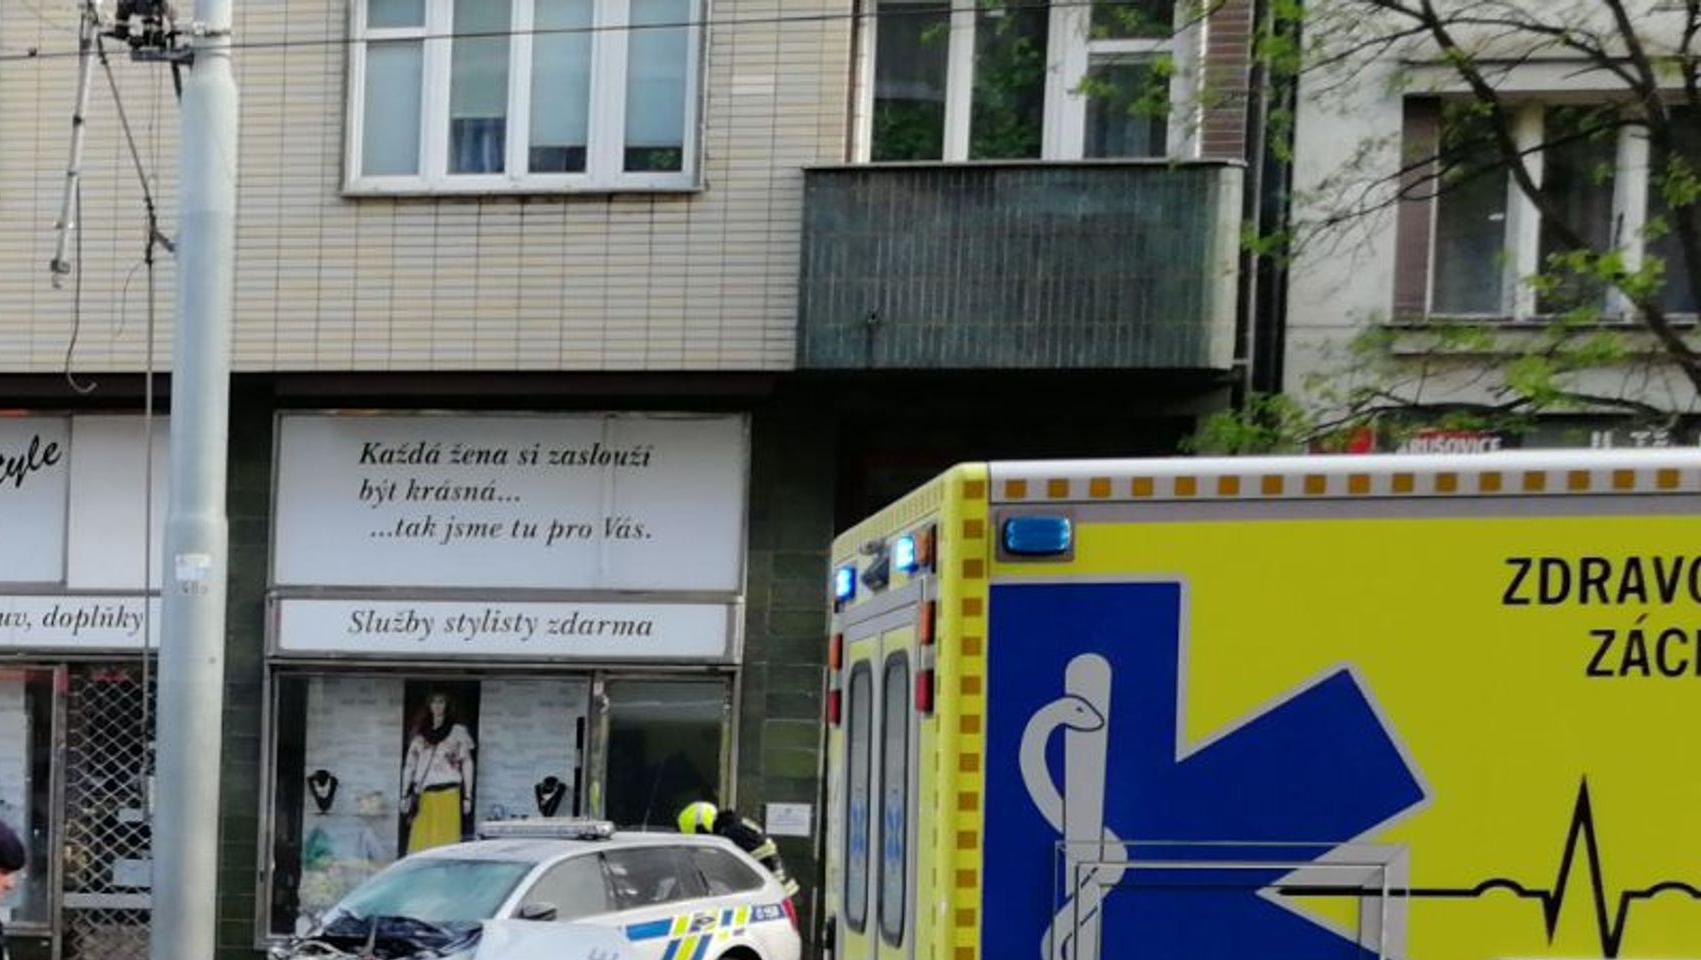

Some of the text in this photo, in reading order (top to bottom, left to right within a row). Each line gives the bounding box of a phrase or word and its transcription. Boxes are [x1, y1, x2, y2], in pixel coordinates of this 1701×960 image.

[359, 440, 653, 469] Každá žena si zaslouží
[359, 478, 521, 507] být krásná...
[370, 514, 653, 546] ...tak jsme tu pro Vás.
[42, 604, 144, 639] doplňky
[347, 608, 653, 642] Služby stylisty zdarma
[1585, 613, 1701, 678] ZÁC
